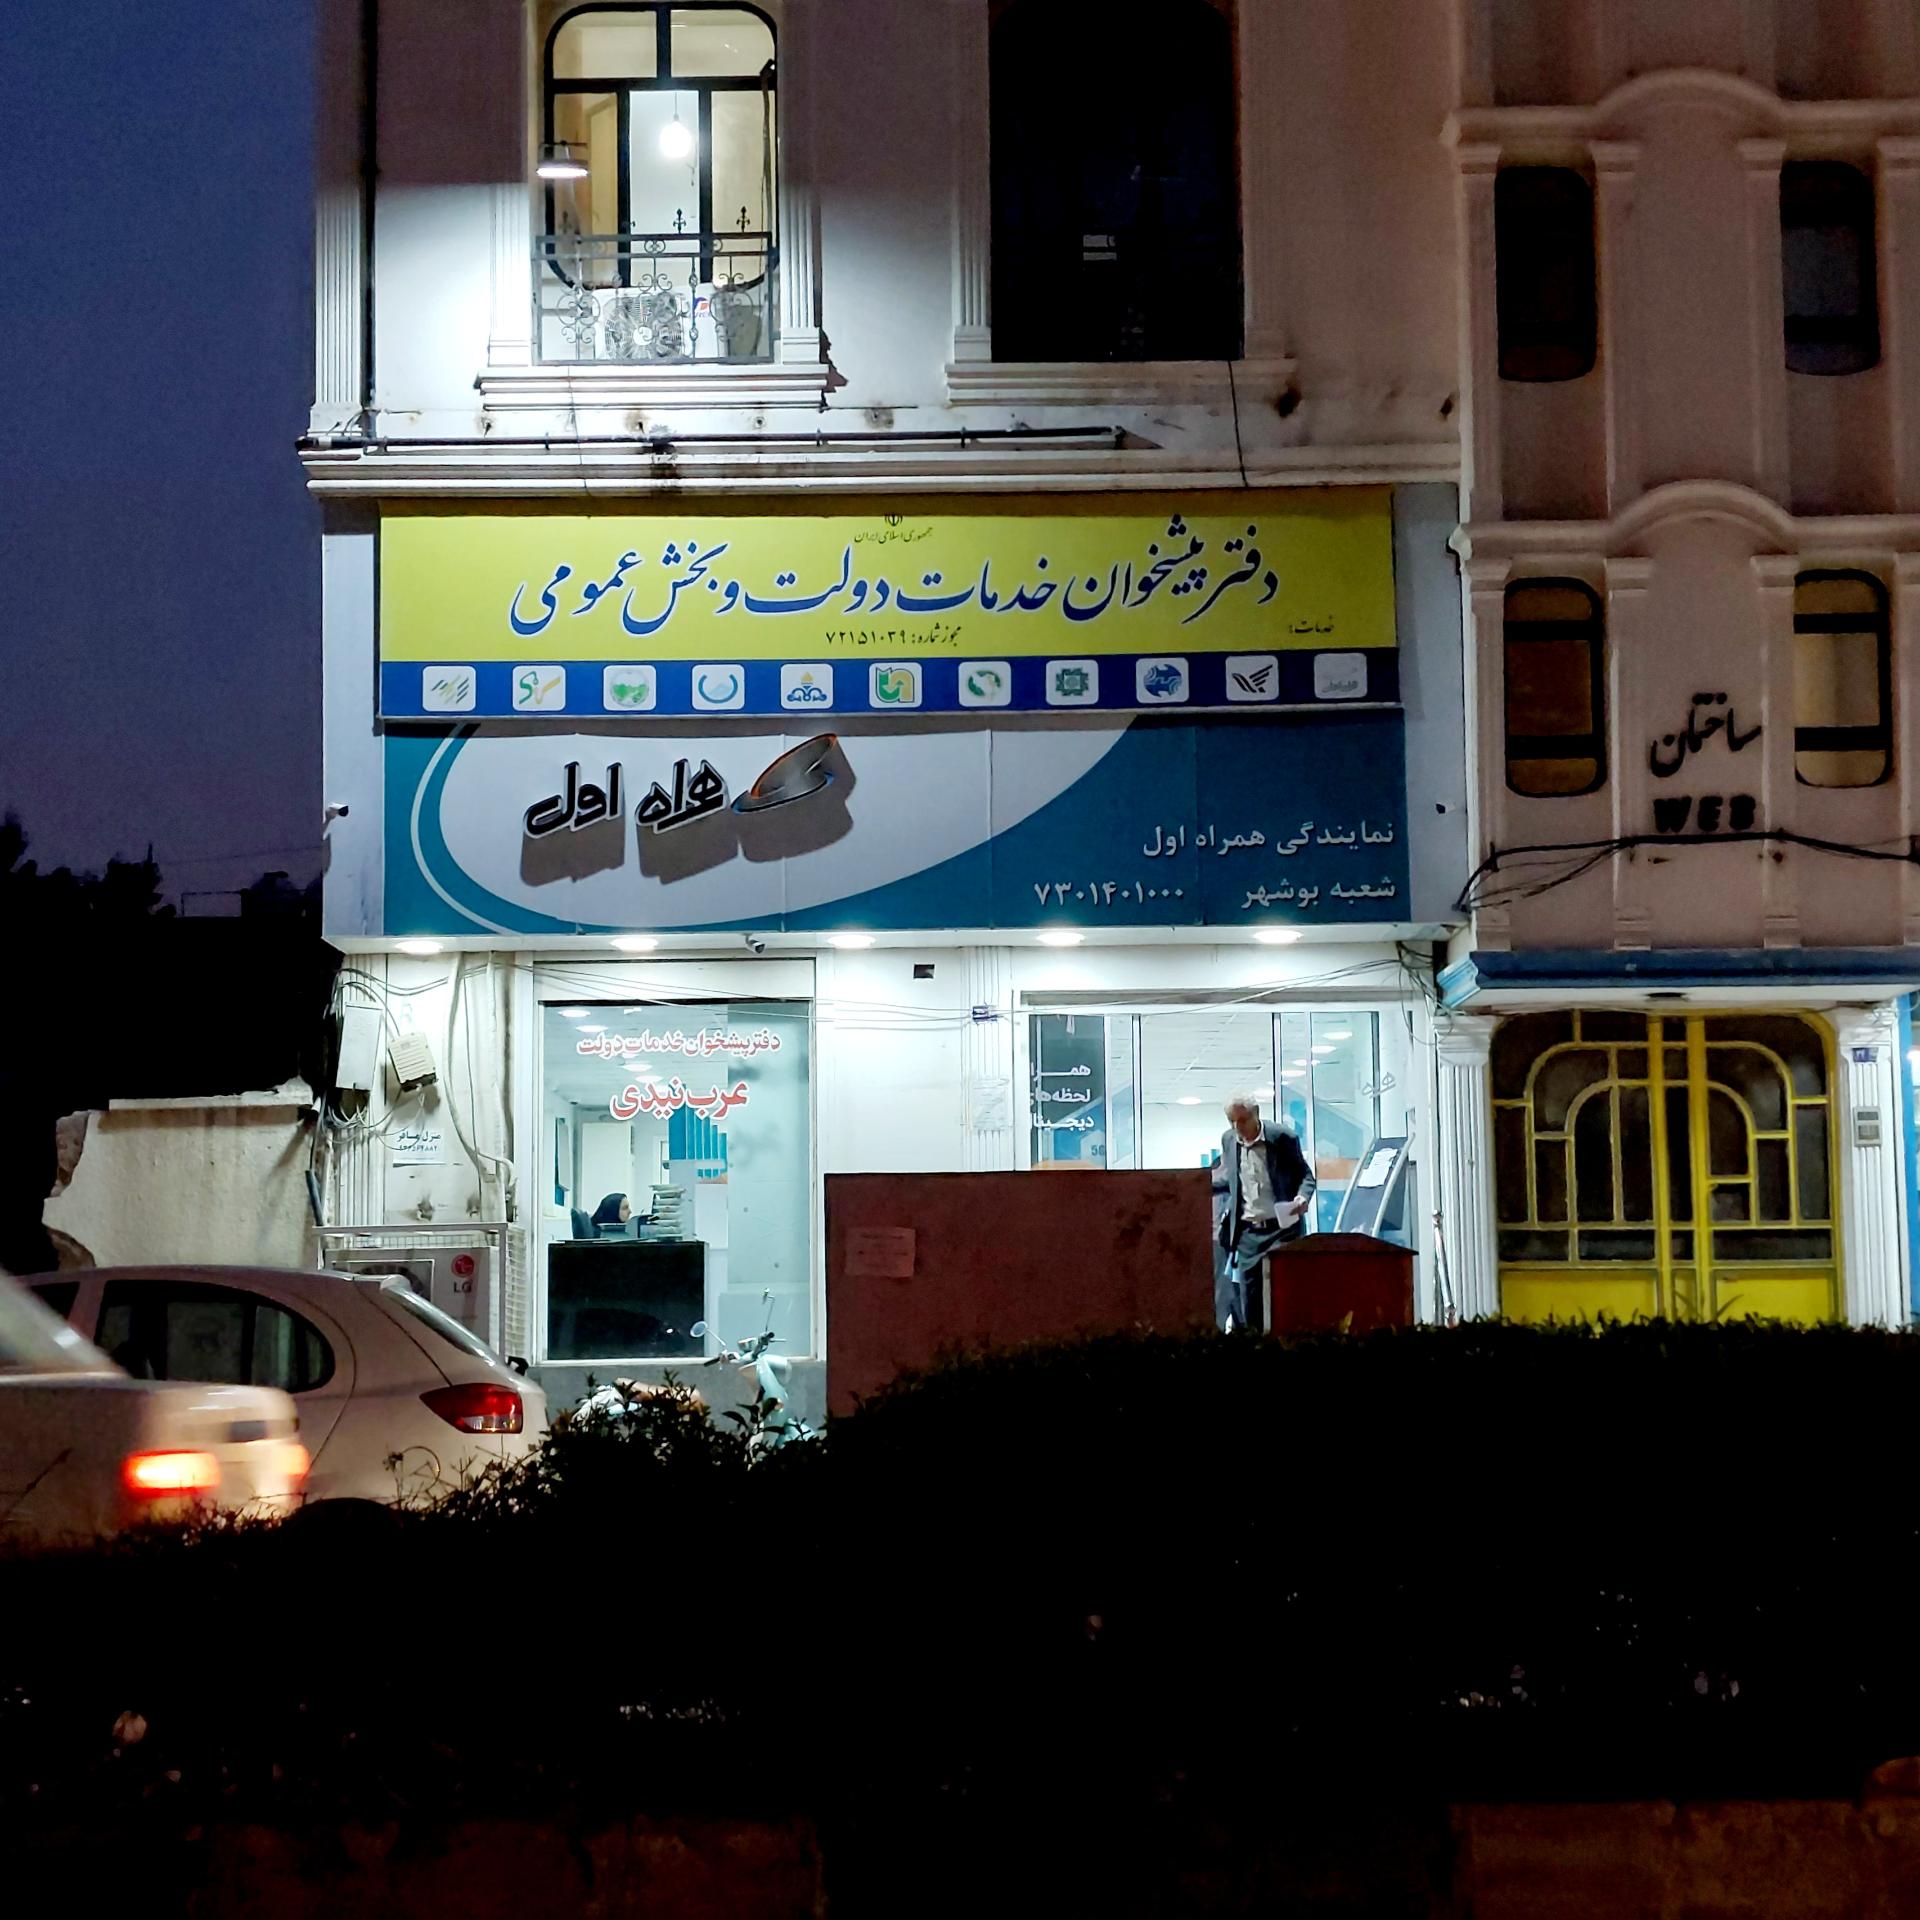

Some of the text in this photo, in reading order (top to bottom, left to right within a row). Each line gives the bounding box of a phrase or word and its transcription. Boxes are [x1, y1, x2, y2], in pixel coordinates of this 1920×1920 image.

[878, 530, 903, 545] اسلامی
[510, 512, 1279, 636] دفتر پیشخوان خدمات دولت و بخش عمومی
[1650, 691, 1763, 778] ساختمان
[523, 758, 726, 839] همراه اول
[1143, 820, 1395, 857] نمایندگی همراه اول
[1033, 880, 1186, 907] ۷۳۰۱۴۰۱۰۰۰
[1240, 876, 1397, 909] شعبه بوشهر
[577, 1028, 782, 1057] دفتر پیشخوان خدمات دولت
[685, 1081, 749, 1119] عرب
[453, 1281, 473, 1293] LG
